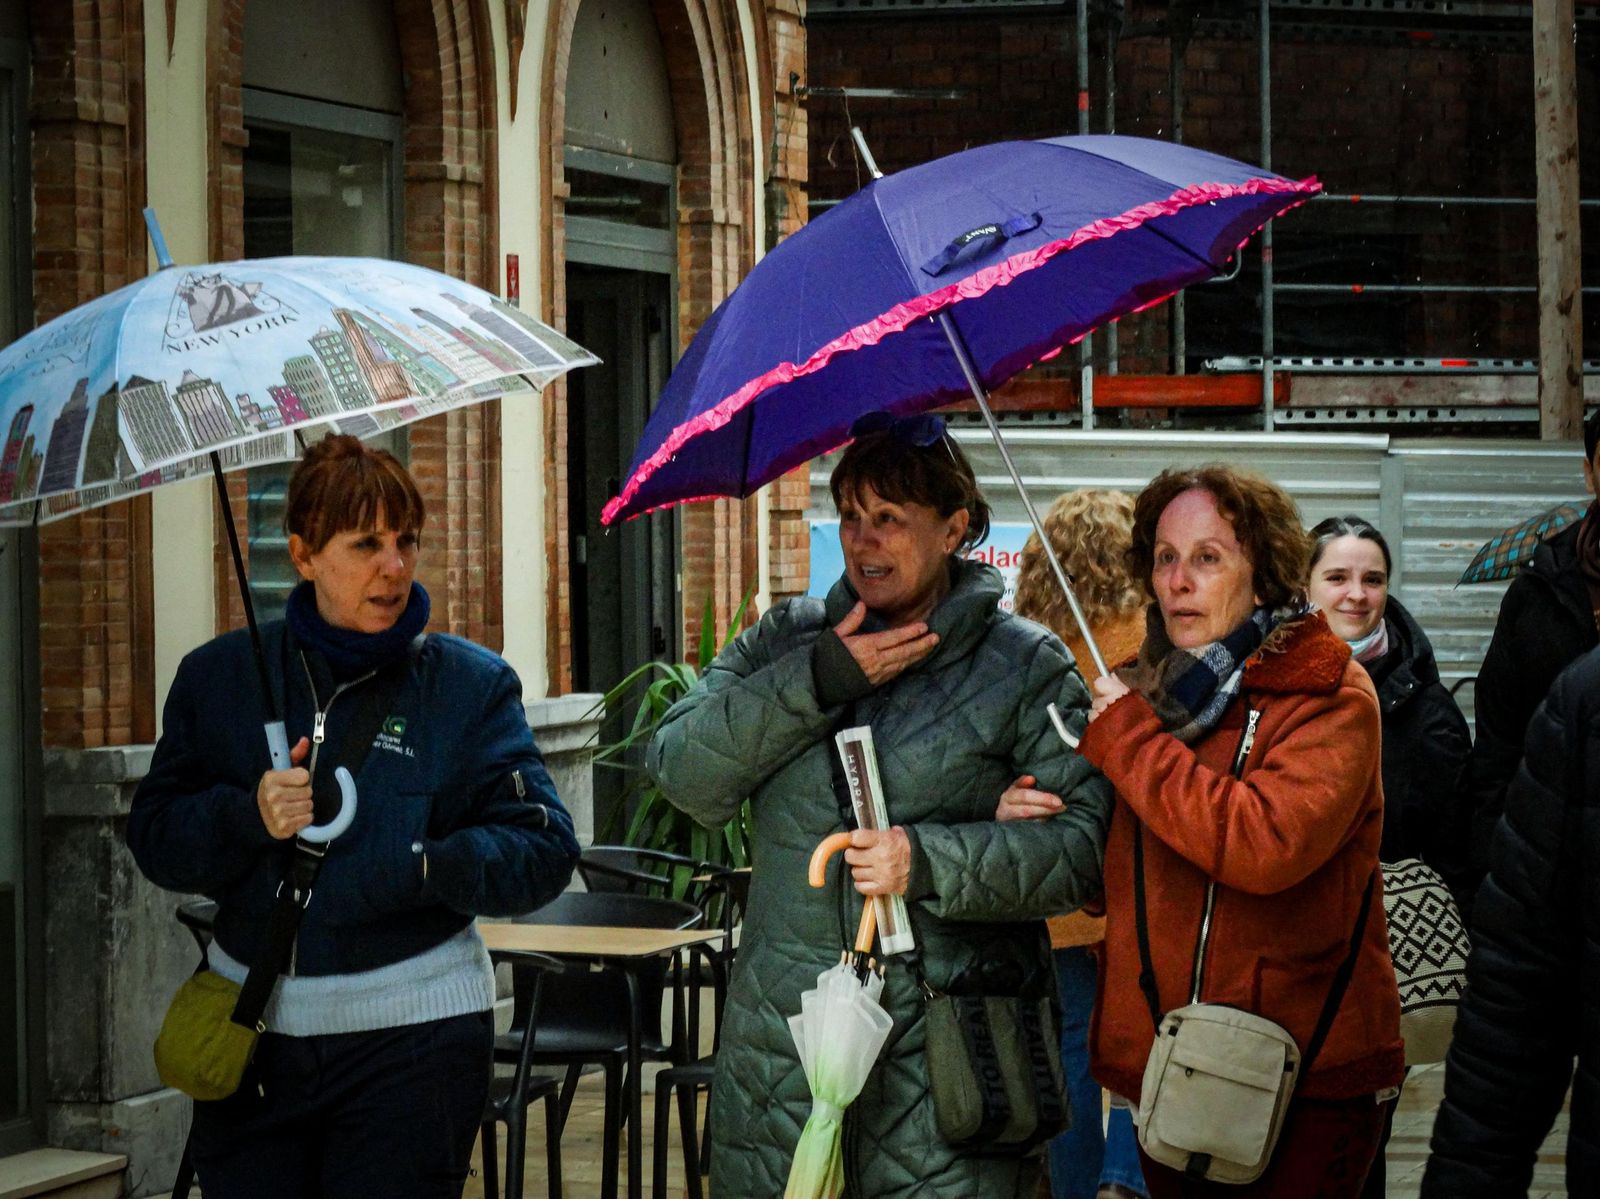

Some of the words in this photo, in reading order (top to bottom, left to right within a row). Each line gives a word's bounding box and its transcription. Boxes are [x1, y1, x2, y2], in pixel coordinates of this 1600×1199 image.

[166, 329, 221, 354] NEW
[229, 313, 299, 339] YORK
[962, 545, 1023, 568] alac
[846, 754, 865, 810] HYDRA
